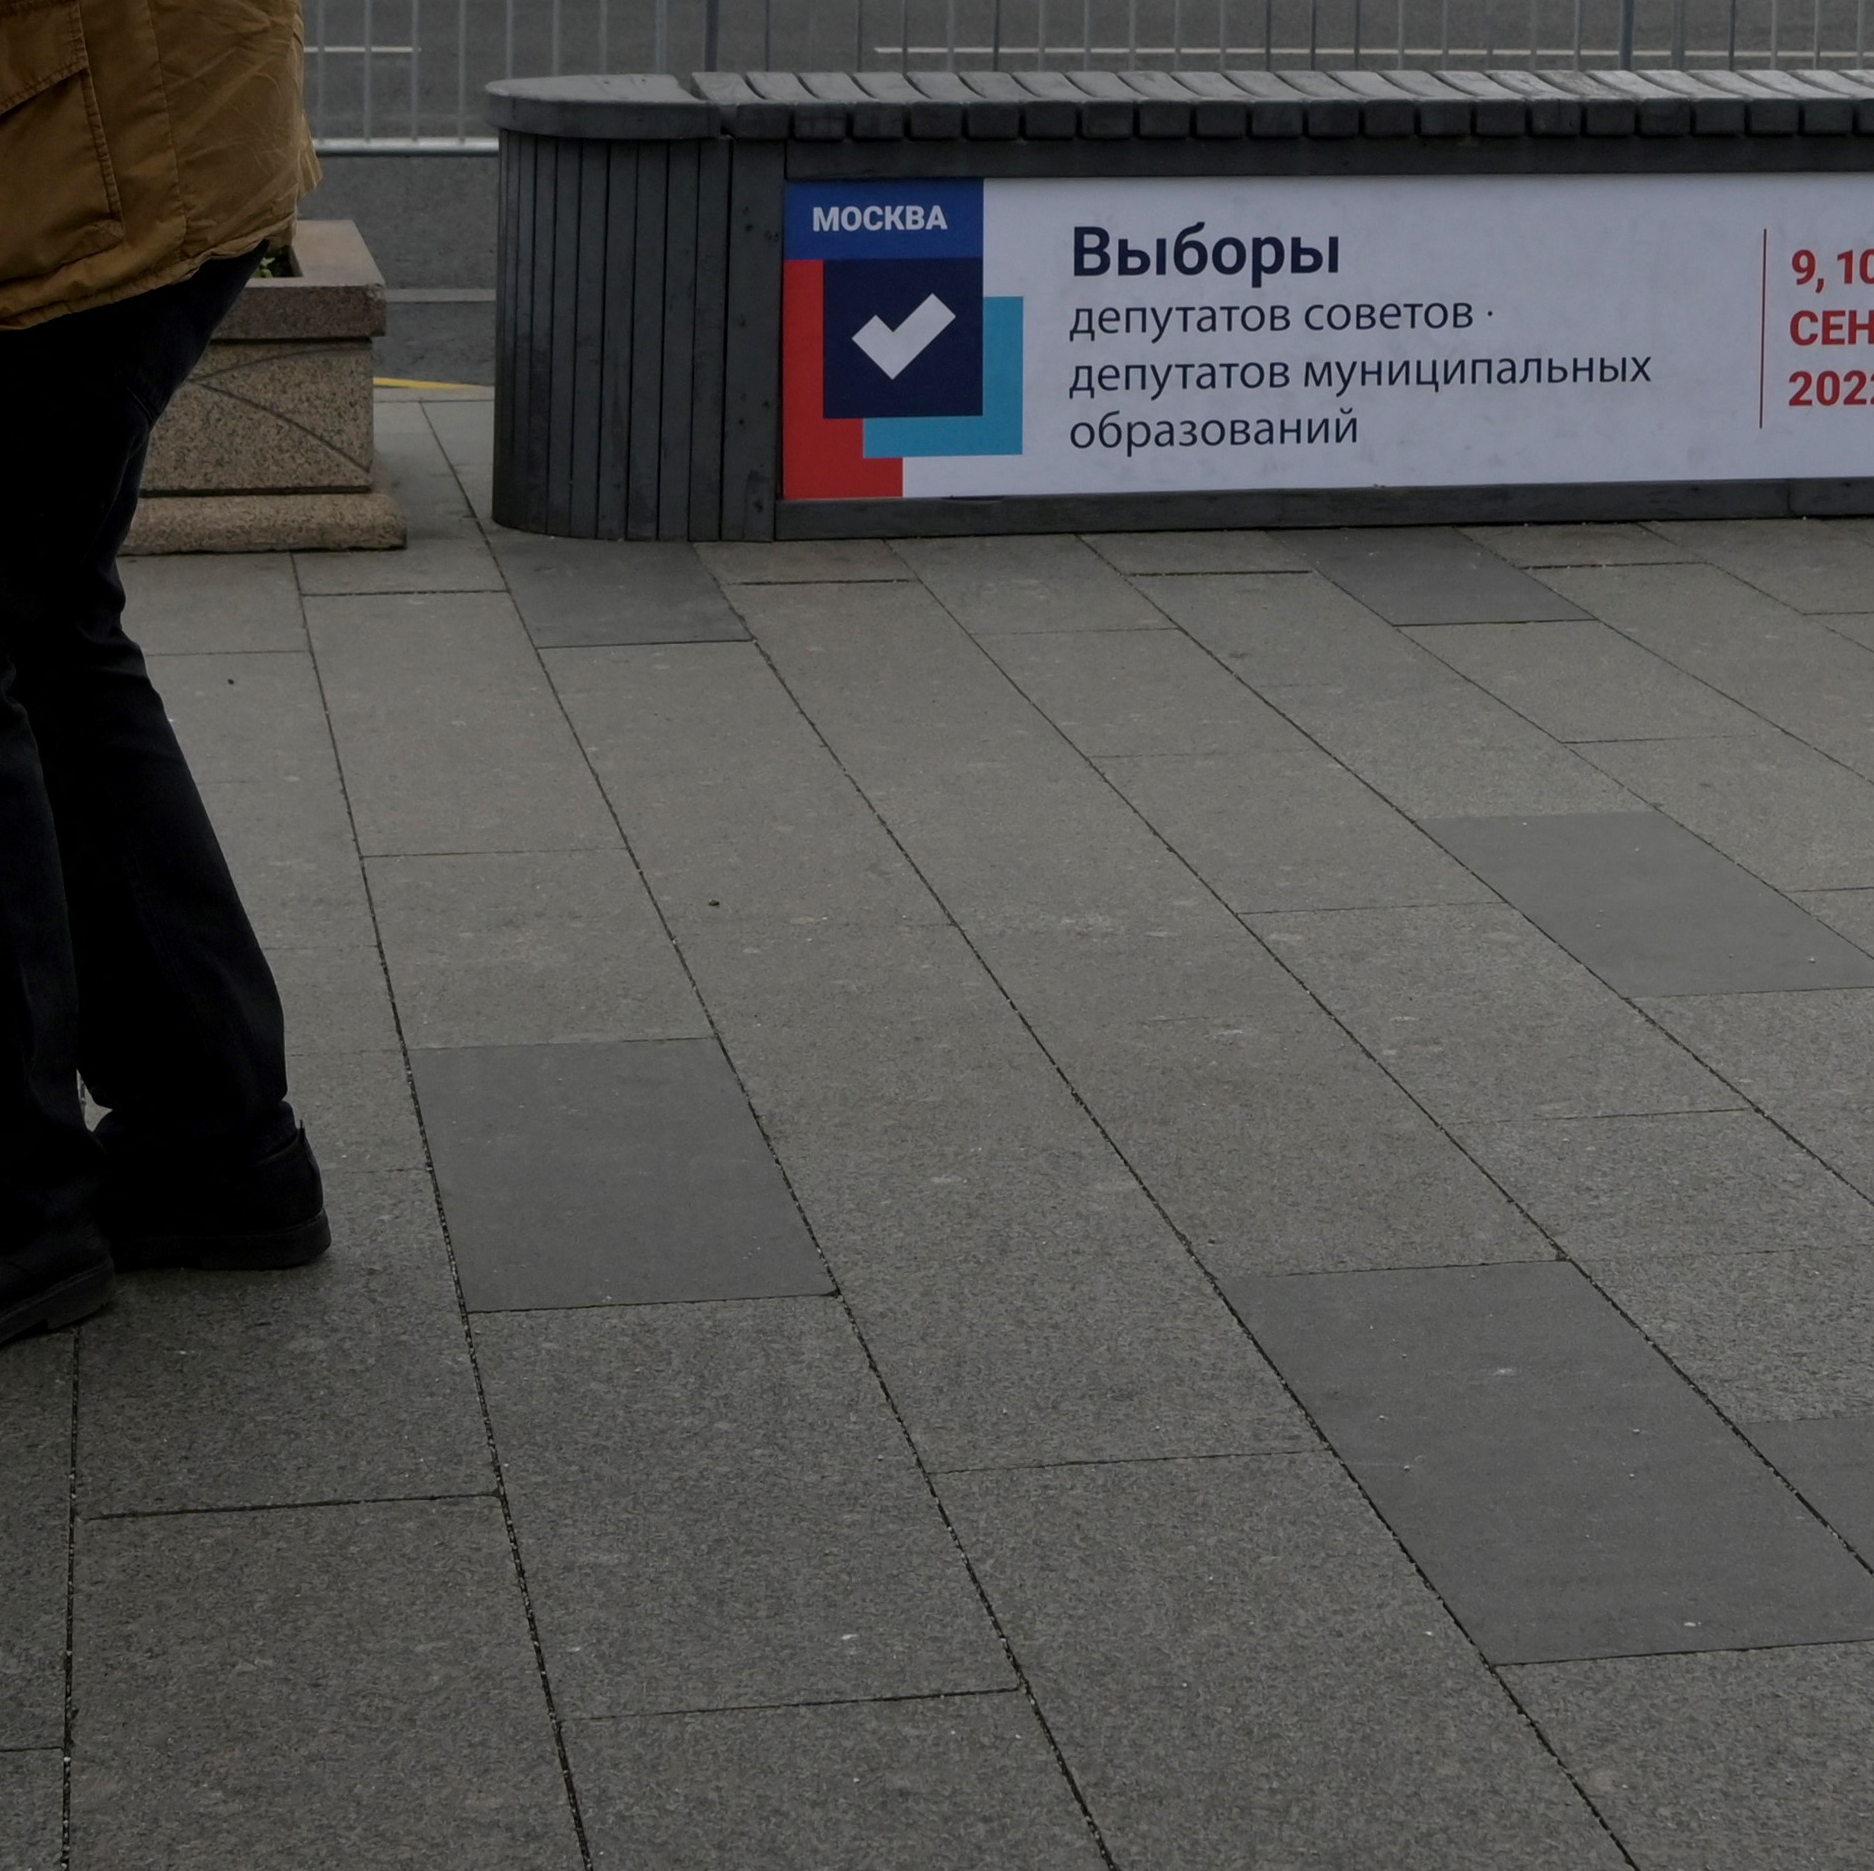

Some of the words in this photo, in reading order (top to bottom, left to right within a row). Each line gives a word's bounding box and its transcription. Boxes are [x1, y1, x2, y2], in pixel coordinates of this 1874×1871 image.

[812, 205, 948, 232] МОСКВА
[1072, 222, 1340, 289] Выборы
[1791, 249, 1825, 293] 9,
[1069, 304, 1291, 343] депутатов
[1303, 301, 1474, 332] советов
[1069, 361, 1291, 400] депутатов
[1303, 354, 1652, 396] муниципальных
[1069, 407, 1358, 458] образований
